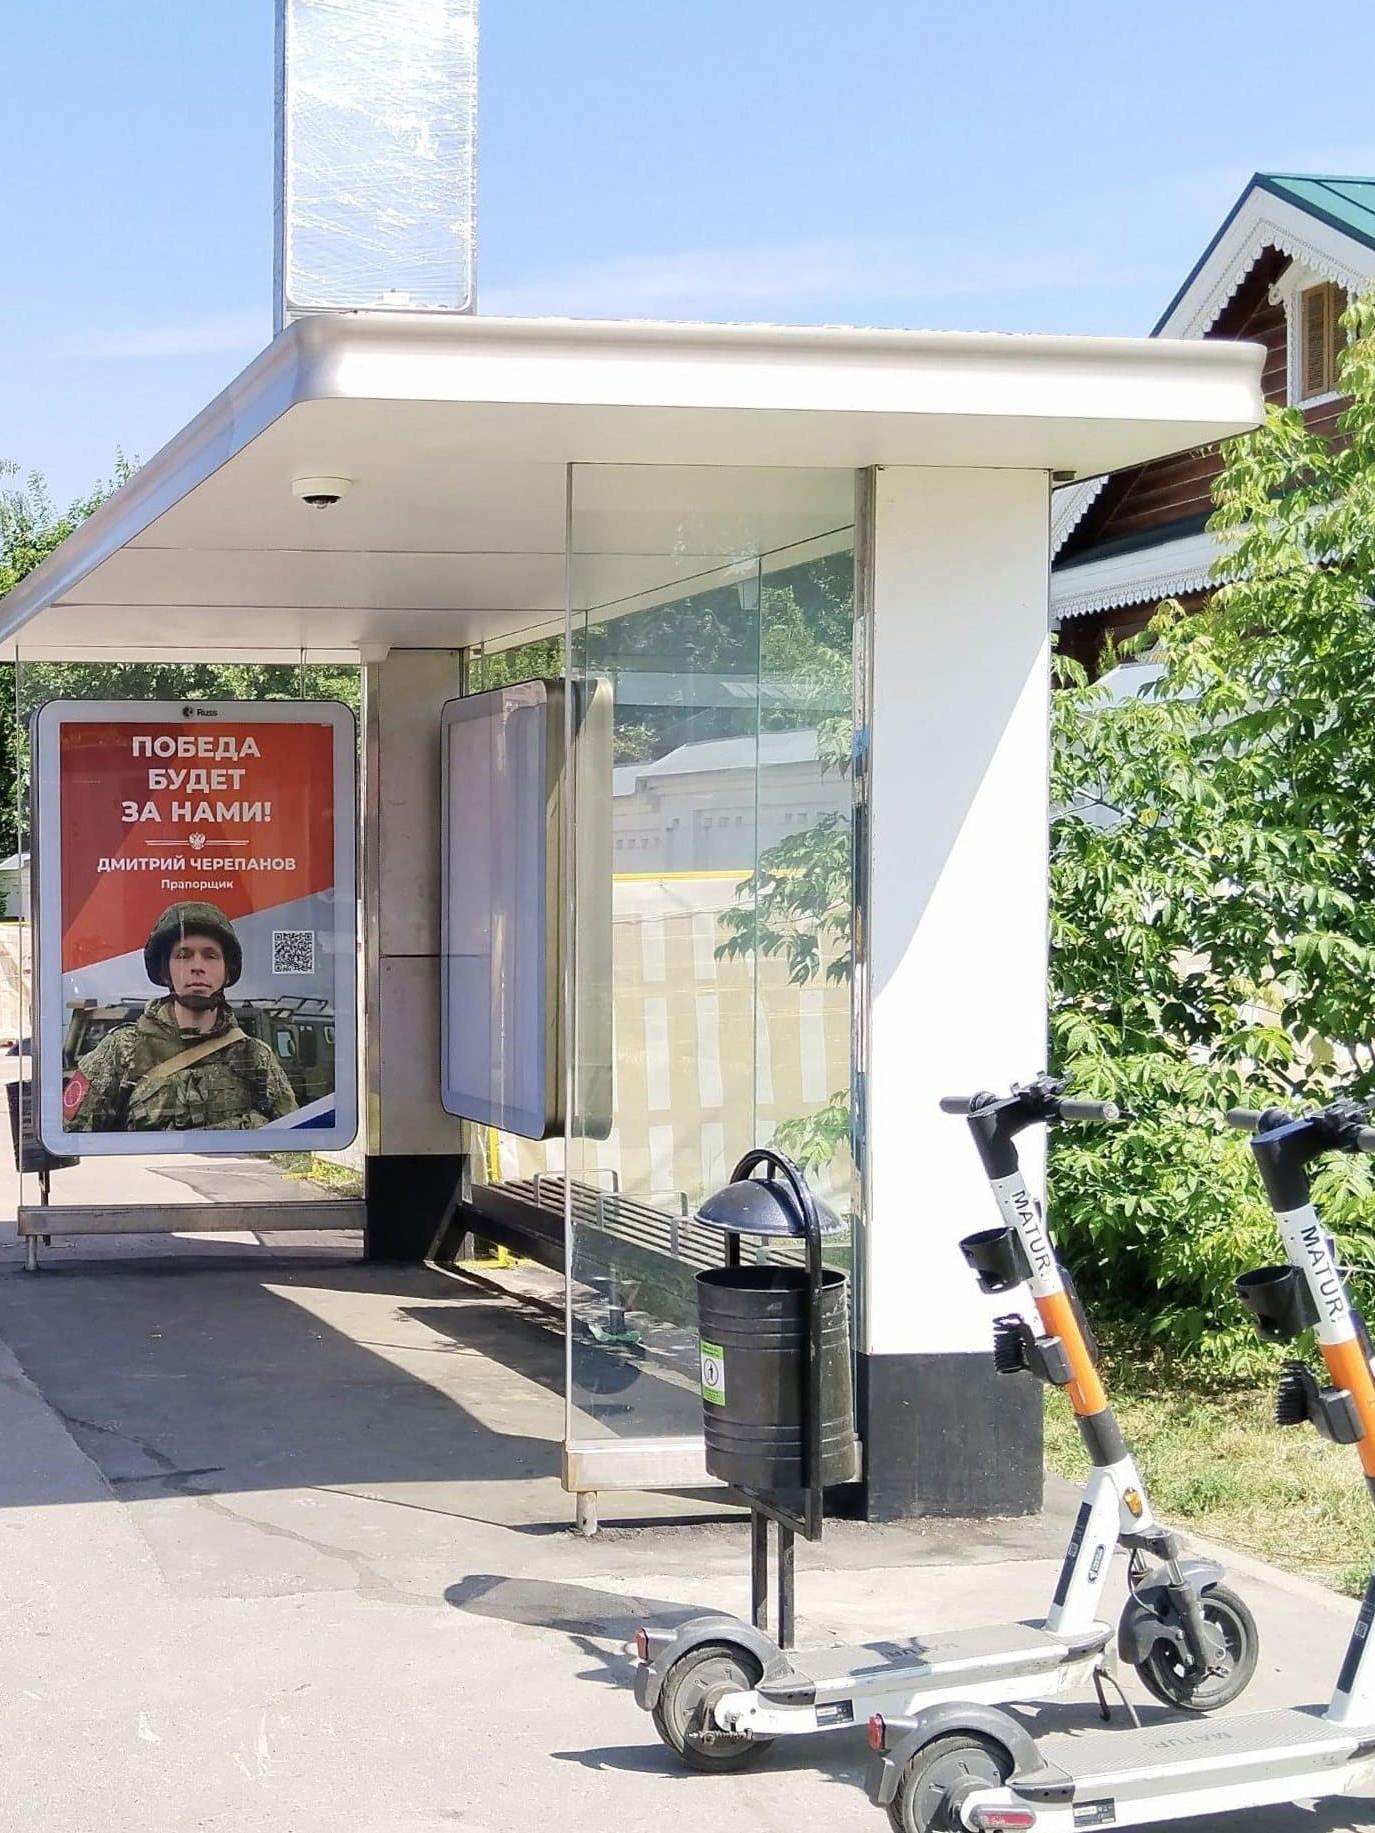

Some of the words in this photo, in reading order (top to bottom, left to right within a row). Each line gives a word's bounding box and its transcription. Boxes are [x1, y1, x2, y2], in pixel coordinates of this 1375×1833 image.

[132, 736, 261, 761] ПОБЕДА
[148, 768, 246, 793] БУДЕТ
[121, 801, 162, 822] ЗА
[171, 801, 272, 822] НАМИ!
[97, 855, 186, 873] ДМИТРИЙ
[190, 858, 297, 871] ЧЕРЕПАНОВ
[161, 879, 234, 890] Прапорщик
